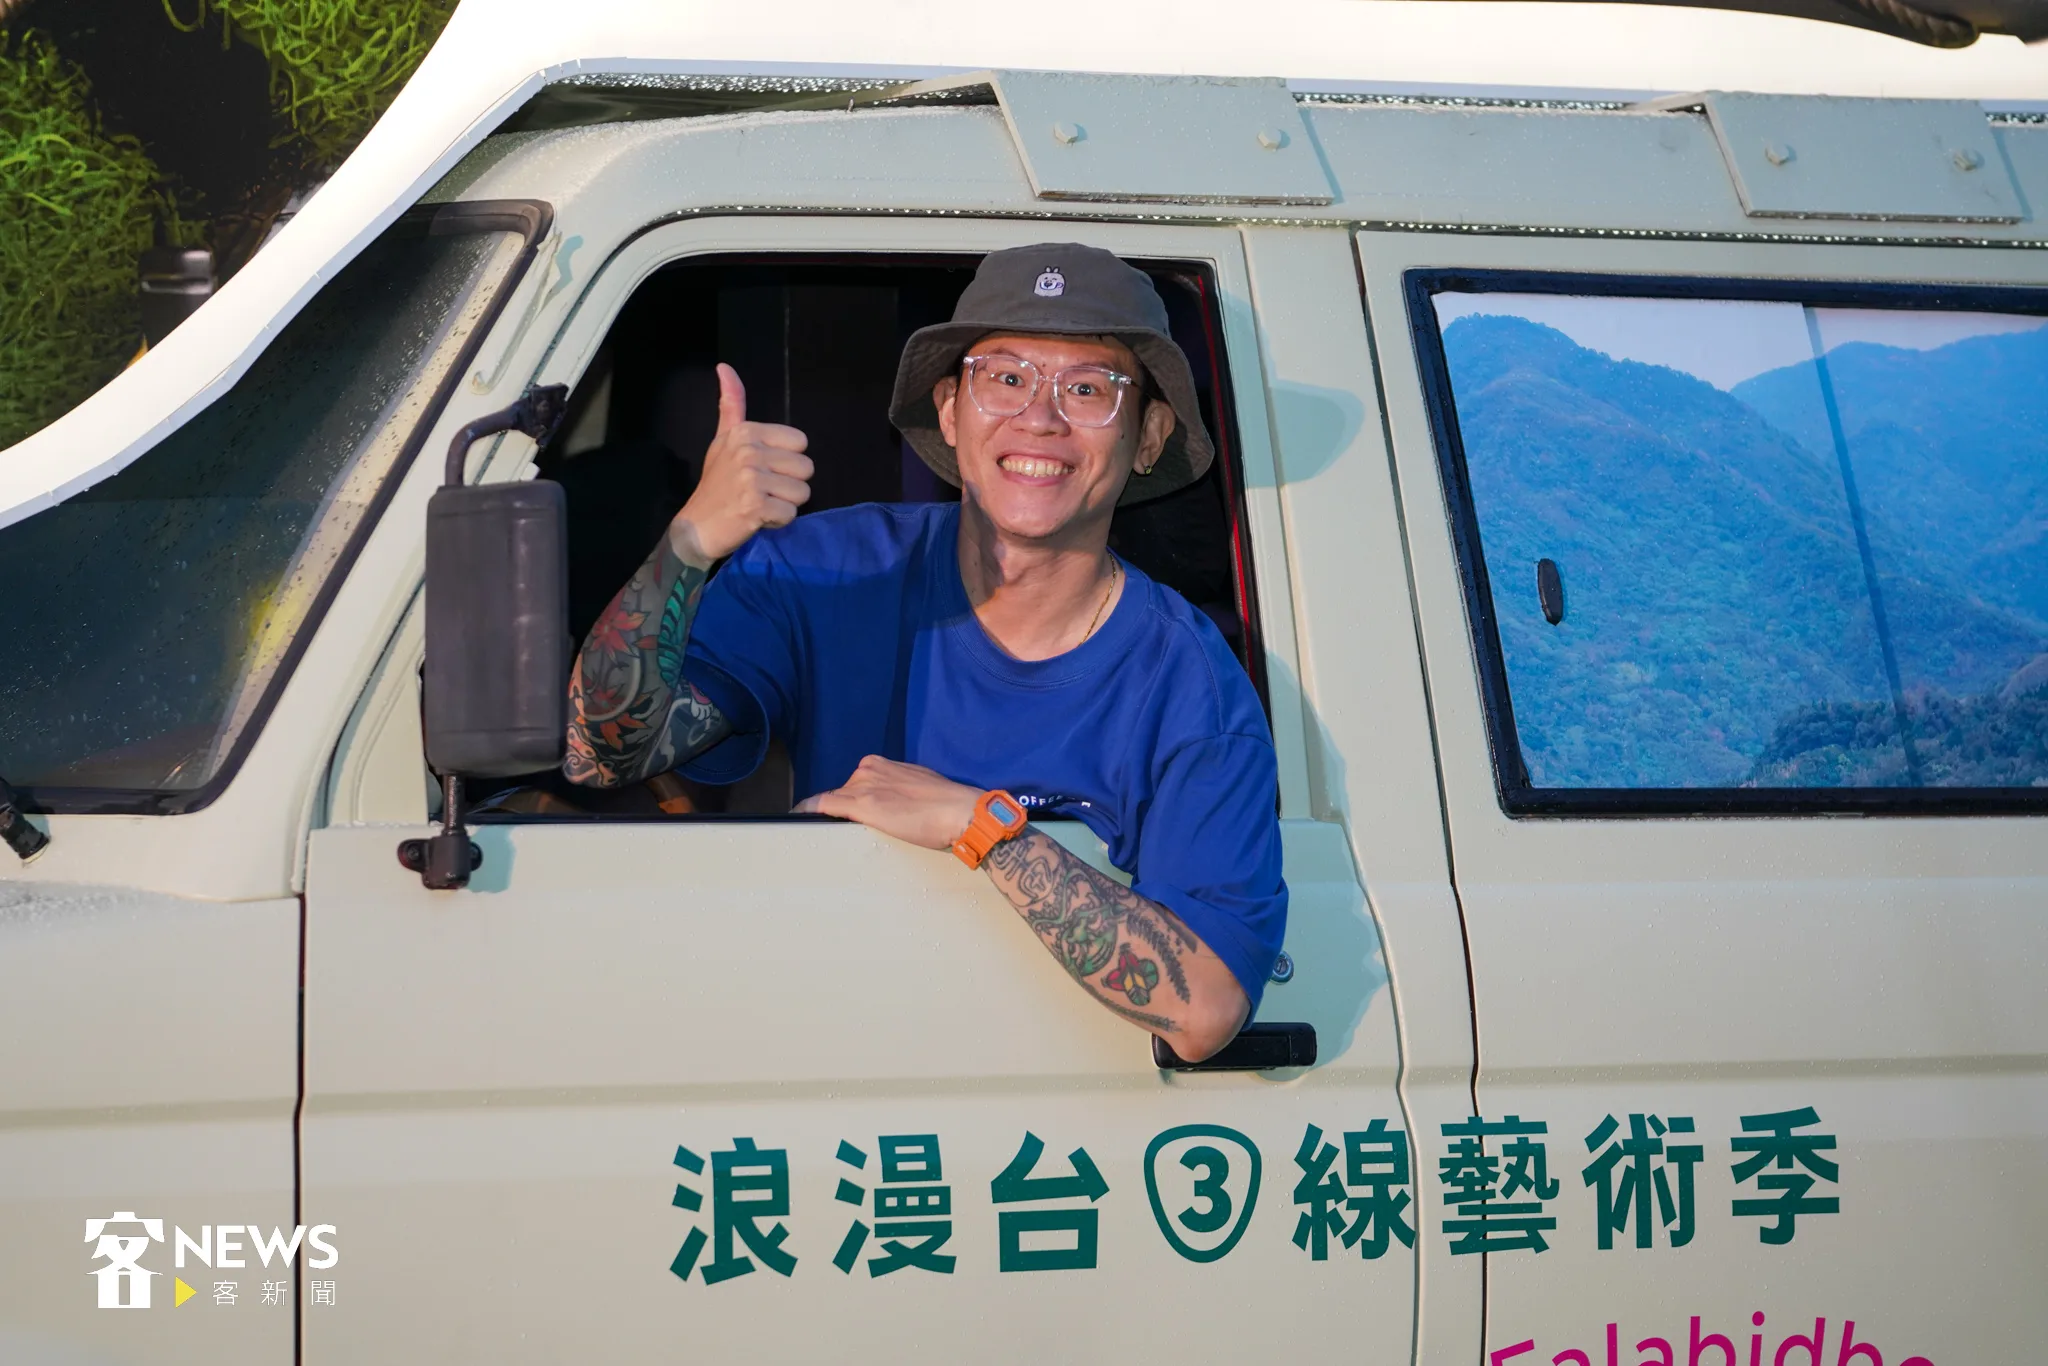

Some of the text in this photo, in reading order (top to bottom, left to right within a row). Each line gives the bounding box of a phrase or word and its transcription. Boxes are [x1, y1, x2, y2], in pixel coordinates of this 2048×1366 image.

[670, 1106, 1840, 1285] 浪漫台3線藝術季
